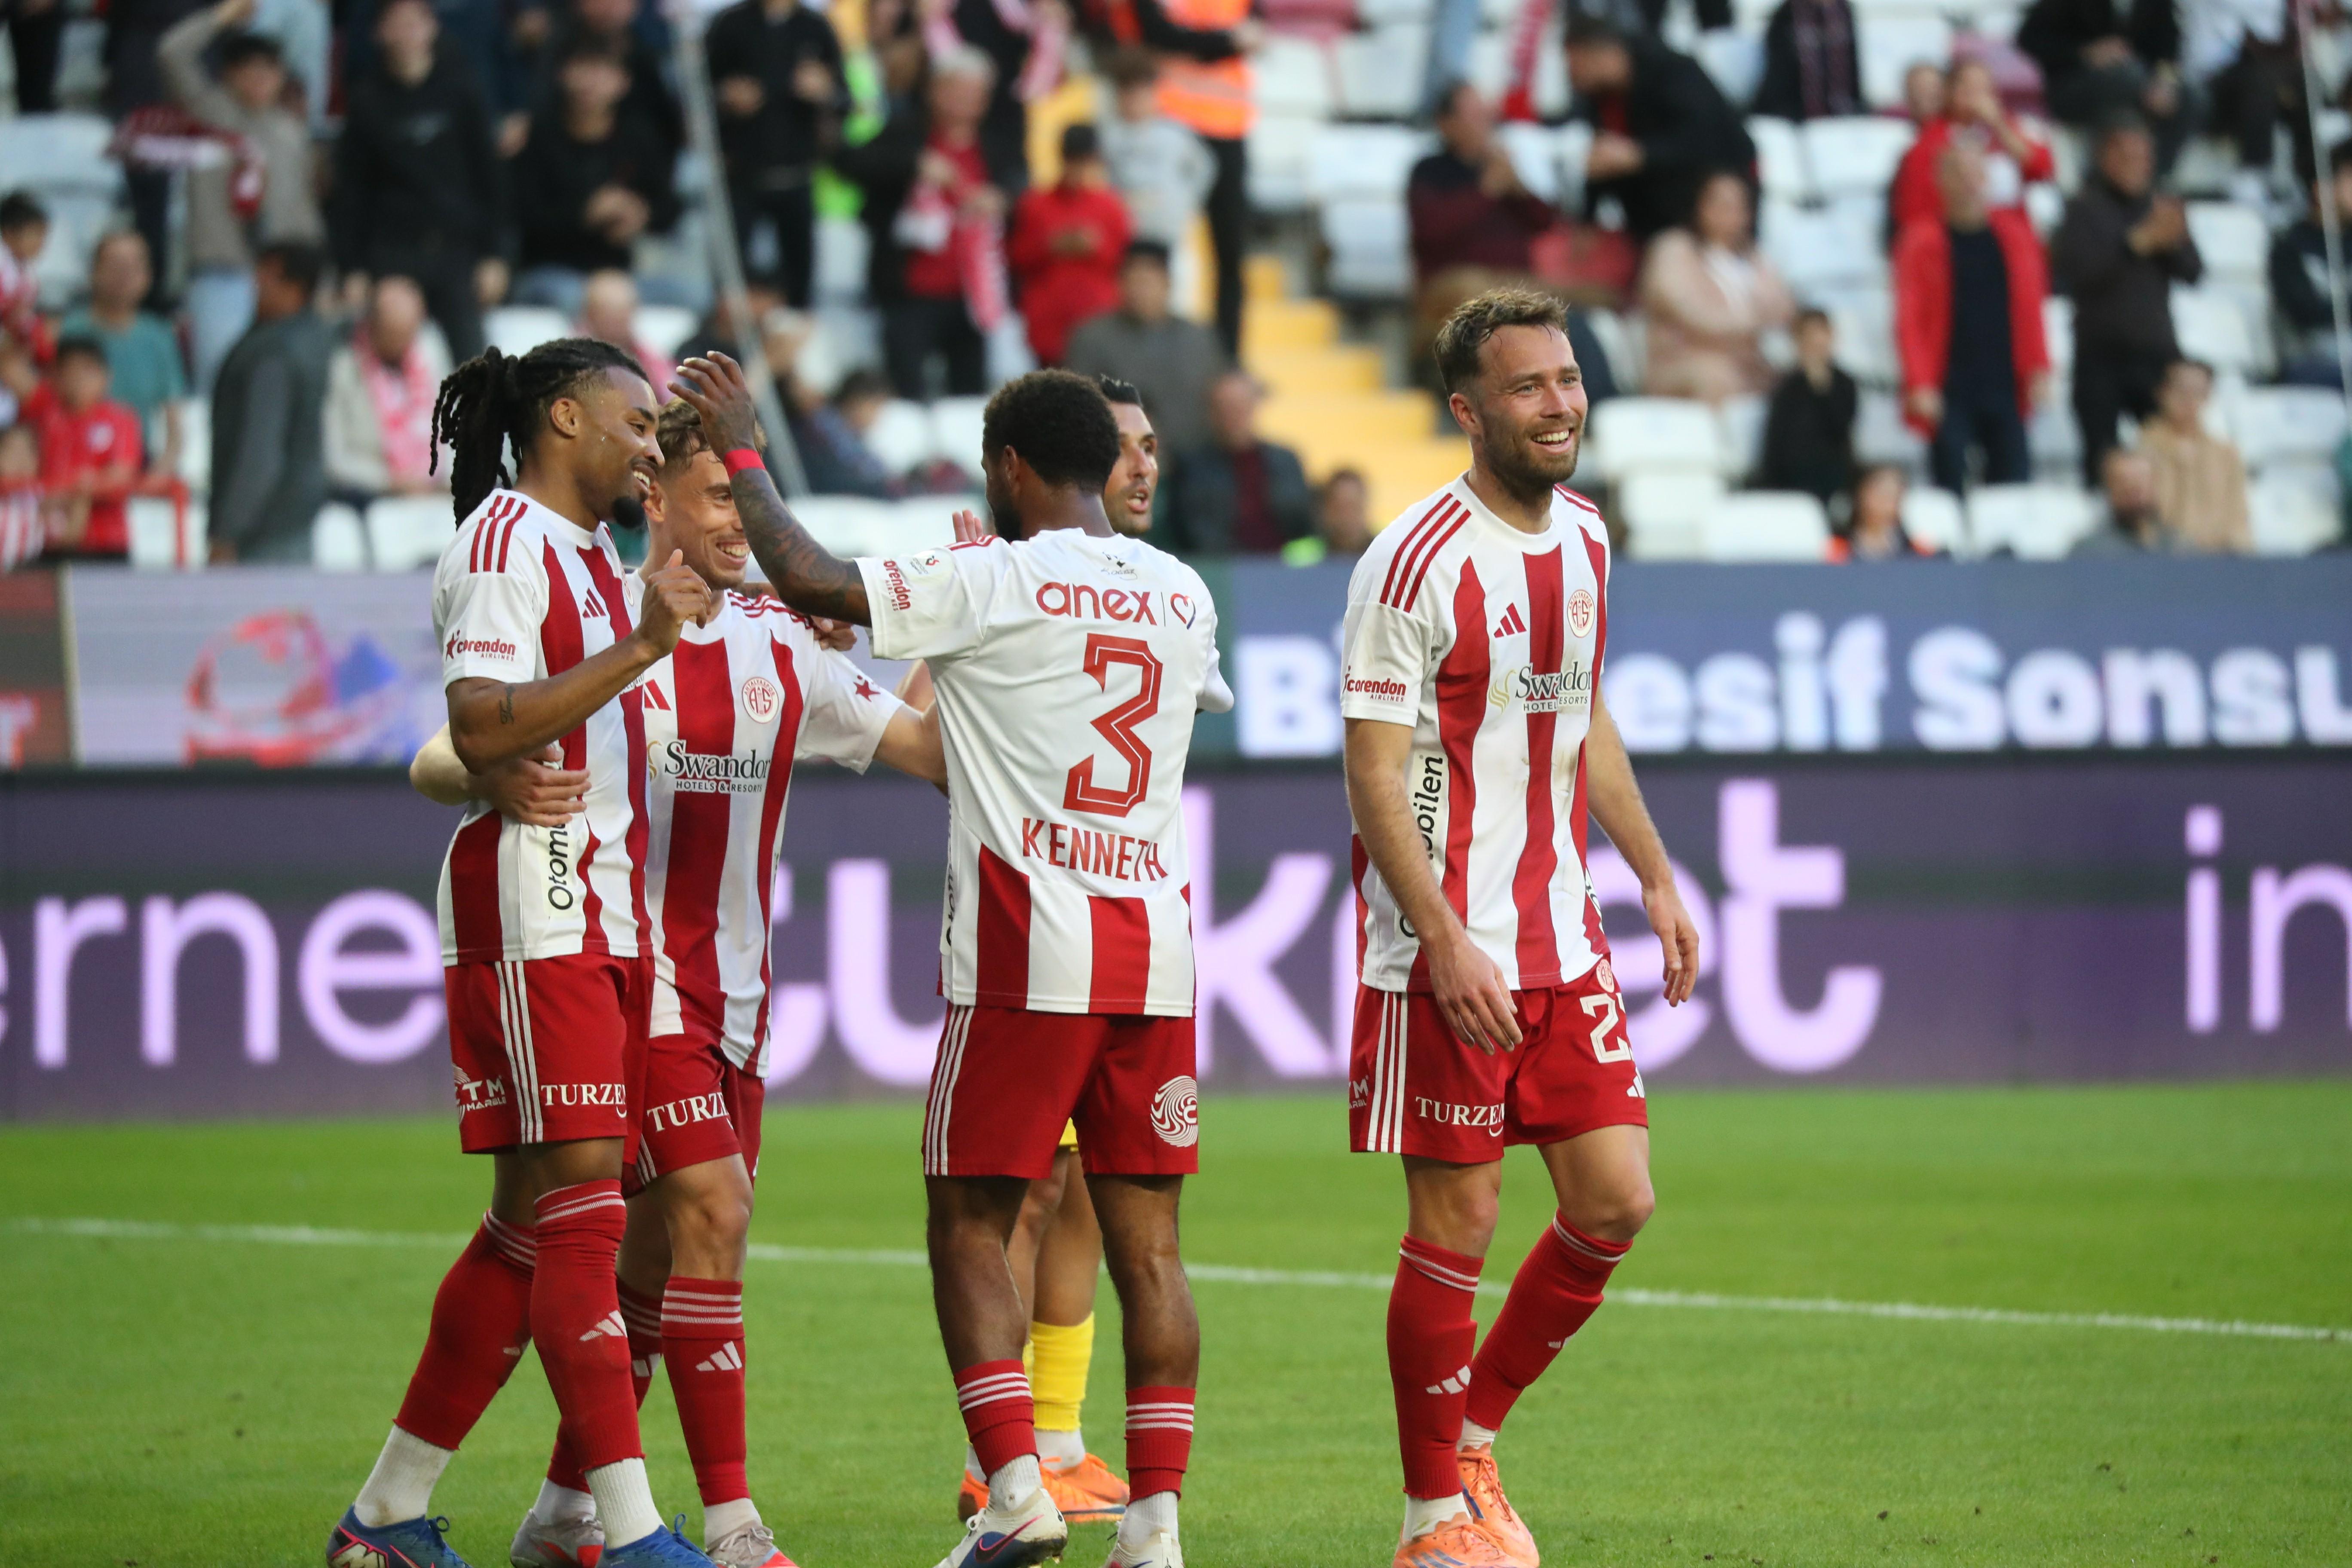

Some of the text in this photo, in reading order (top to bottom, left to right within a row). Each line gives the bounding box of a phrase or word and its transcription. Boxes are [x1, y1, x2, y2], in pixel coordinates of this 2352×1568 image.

[884, 559, 911, 610] orendon
[1036, 582, 1158, 626] anex
[457, 638, 516, 655] corendon
[481, 652, 514, 662] AIRLINES
[1347, 677, 1406, 695] corendon
[1370, 694, 1404, 702] AIRLINES
[1524, 696, 1588, 711] HOTEL ESORTS
[1063, 633, 1163, 818] 3
[665, 740, 770, 779] Swandor
[677, 780, 763, 793] HOTELS & RESORTS
[548, 823, 574, 910] Otom
[1022, 817, 1168, 882] KENNETH
[0, 888, 447, 1068] rne
[1579, 992, 1633, 1064] 2
